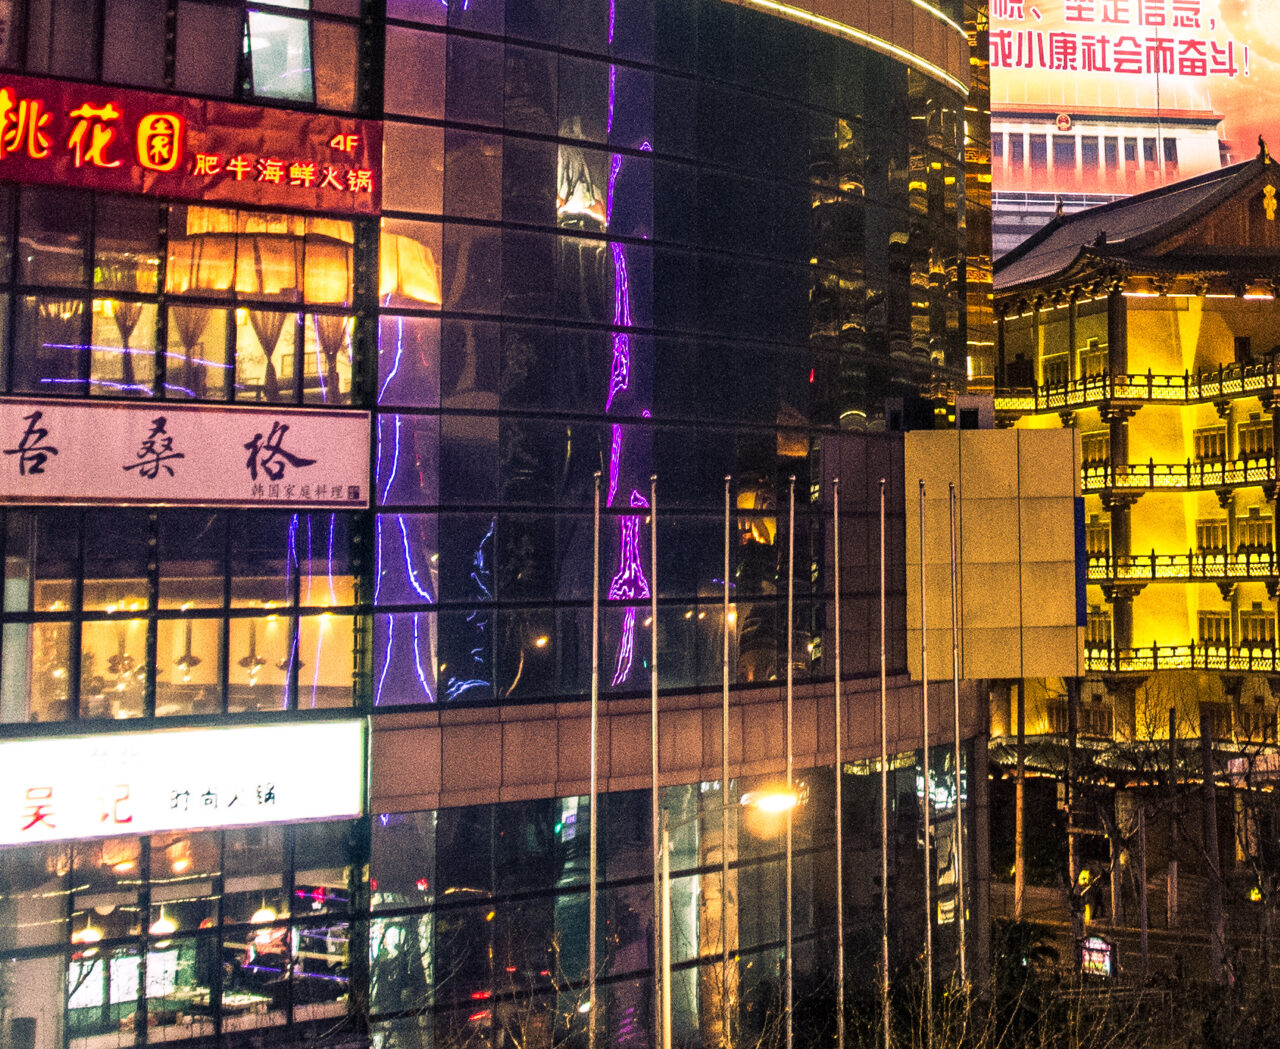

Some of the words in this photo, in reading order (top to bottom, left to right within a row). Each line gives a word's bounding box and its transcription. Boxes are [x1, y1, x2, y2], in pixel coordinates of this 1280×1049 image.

[329, 134, 360, 152] 4F
[194, 154, 374, 193] 肥牛海鲜火锅
[2, 411, 317, 482] 吾桑格
[251, 483, 343, 499] 韩国家庭料理
[21, 784, 133, 831] 吴记
